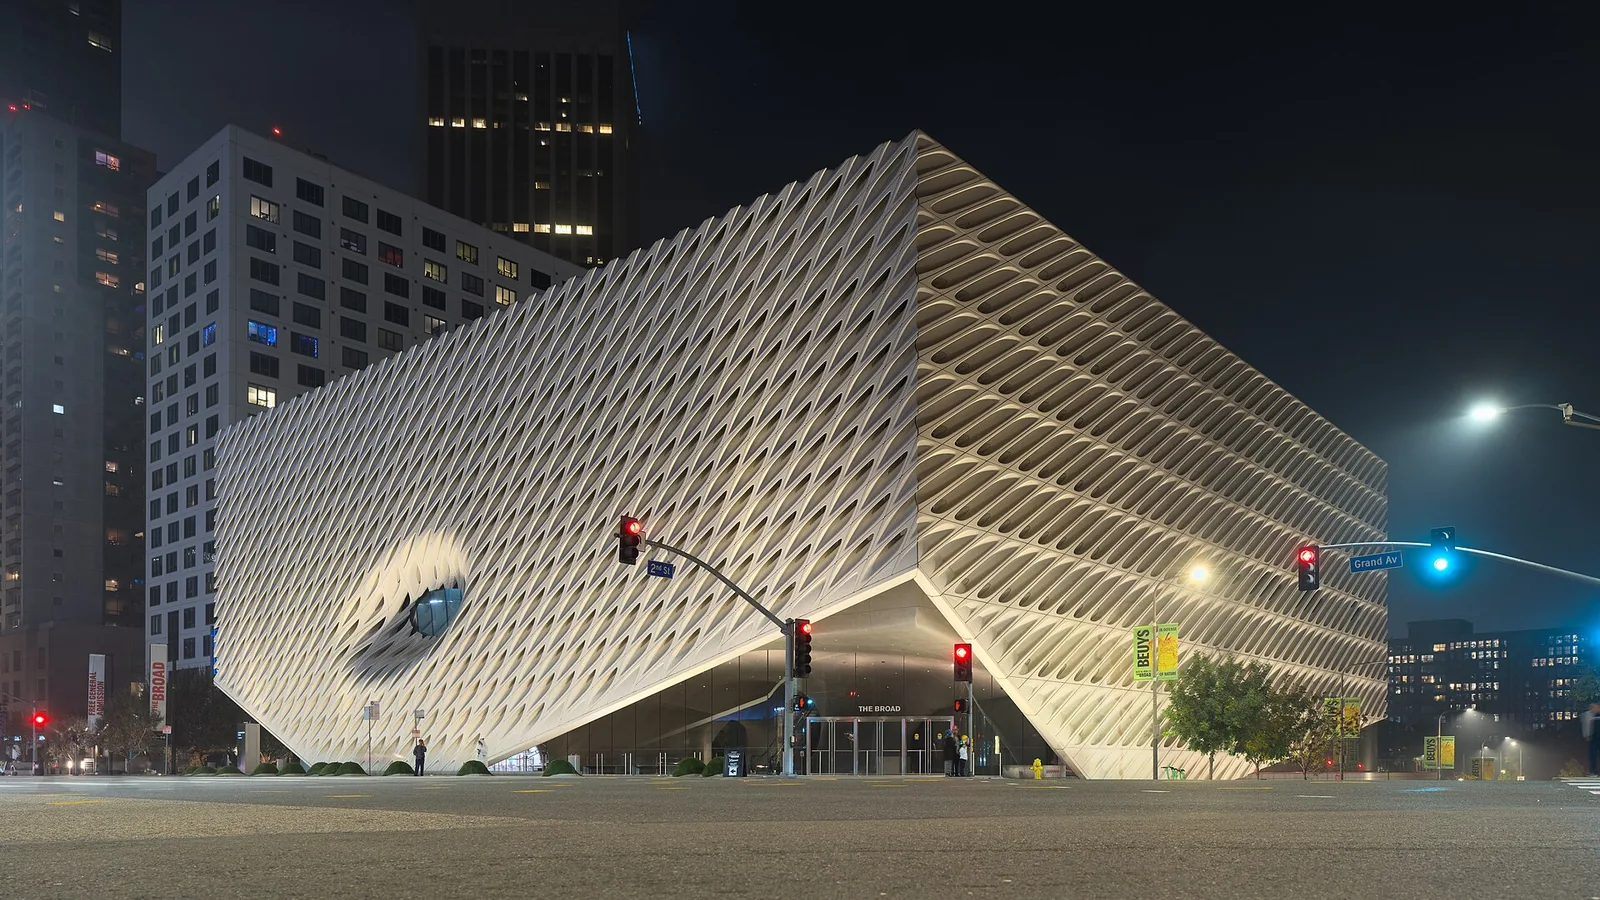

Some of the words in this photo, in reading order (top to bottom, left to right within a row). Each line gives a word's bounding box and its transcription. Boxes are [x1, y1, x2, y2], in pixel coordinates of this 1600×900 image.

[650, 563, 662, 573] 2nd
[663, 566, 670, 575] St
[1354, 557, 1382, 568] Grand
[1386, 556, 1397, 564] Av
[1137, 629, 1149, 667] BEUYS
[89, 672, 97, 700] GENERAL
[152, 662, 165, 701] BROAD
[96, 681, 104, 716] ADMISSION
[1426, 739, 1435, 760] BEUYS
